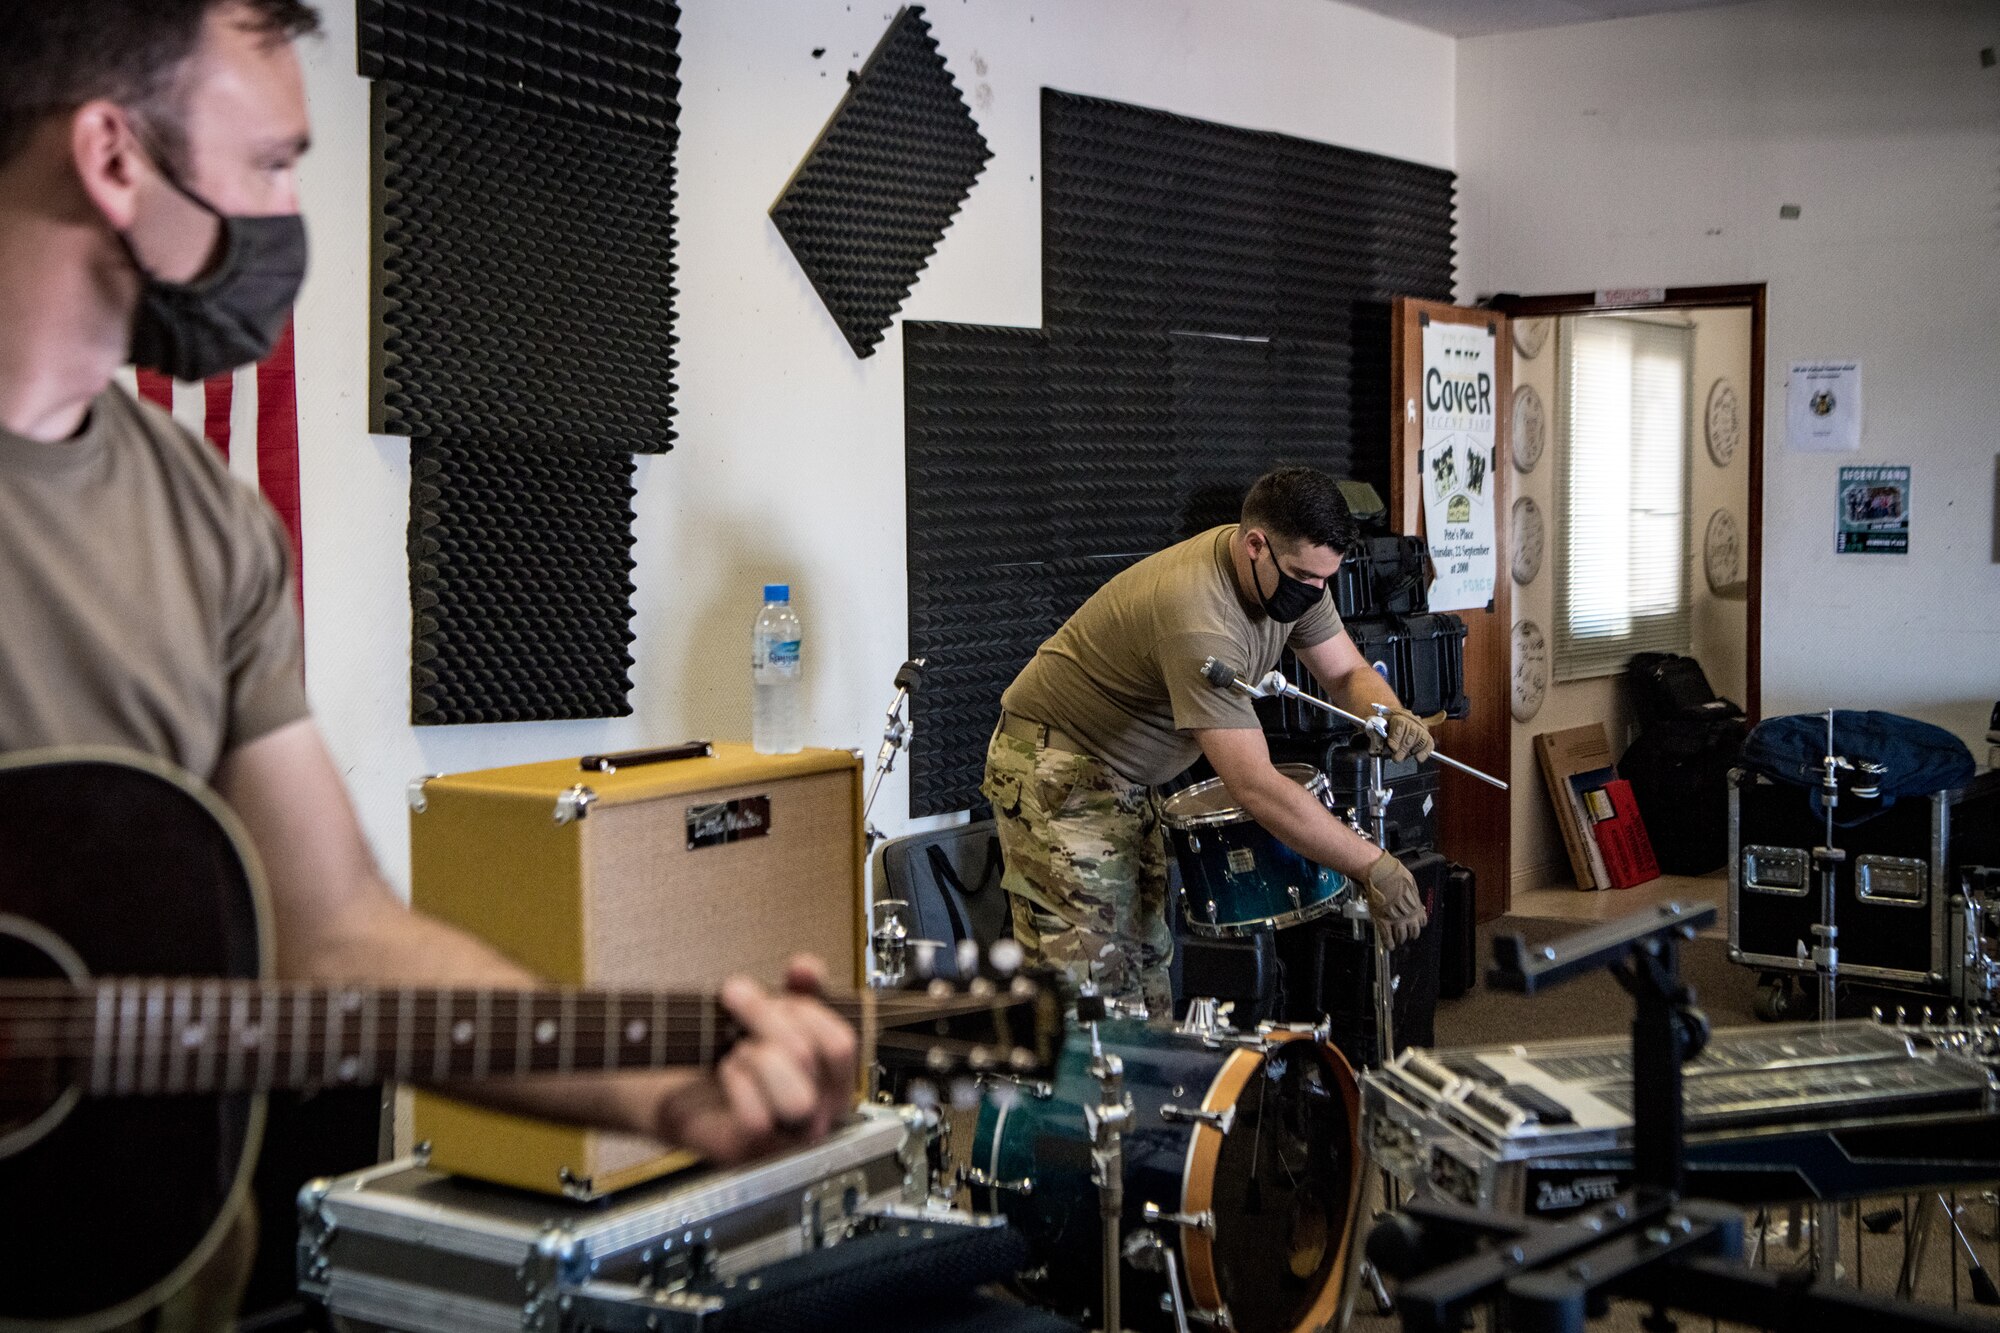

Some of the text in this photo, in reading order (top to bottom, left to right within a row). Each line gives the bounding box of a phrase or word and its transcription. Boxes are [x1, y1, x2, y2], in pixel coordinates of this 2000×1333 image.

[1426, 367, 1491, 414] CoveR
[1460, 528, 1474, 540] Place
[1462, 544, 1490, 559] September
[1450, 564, 1456, 574] at
